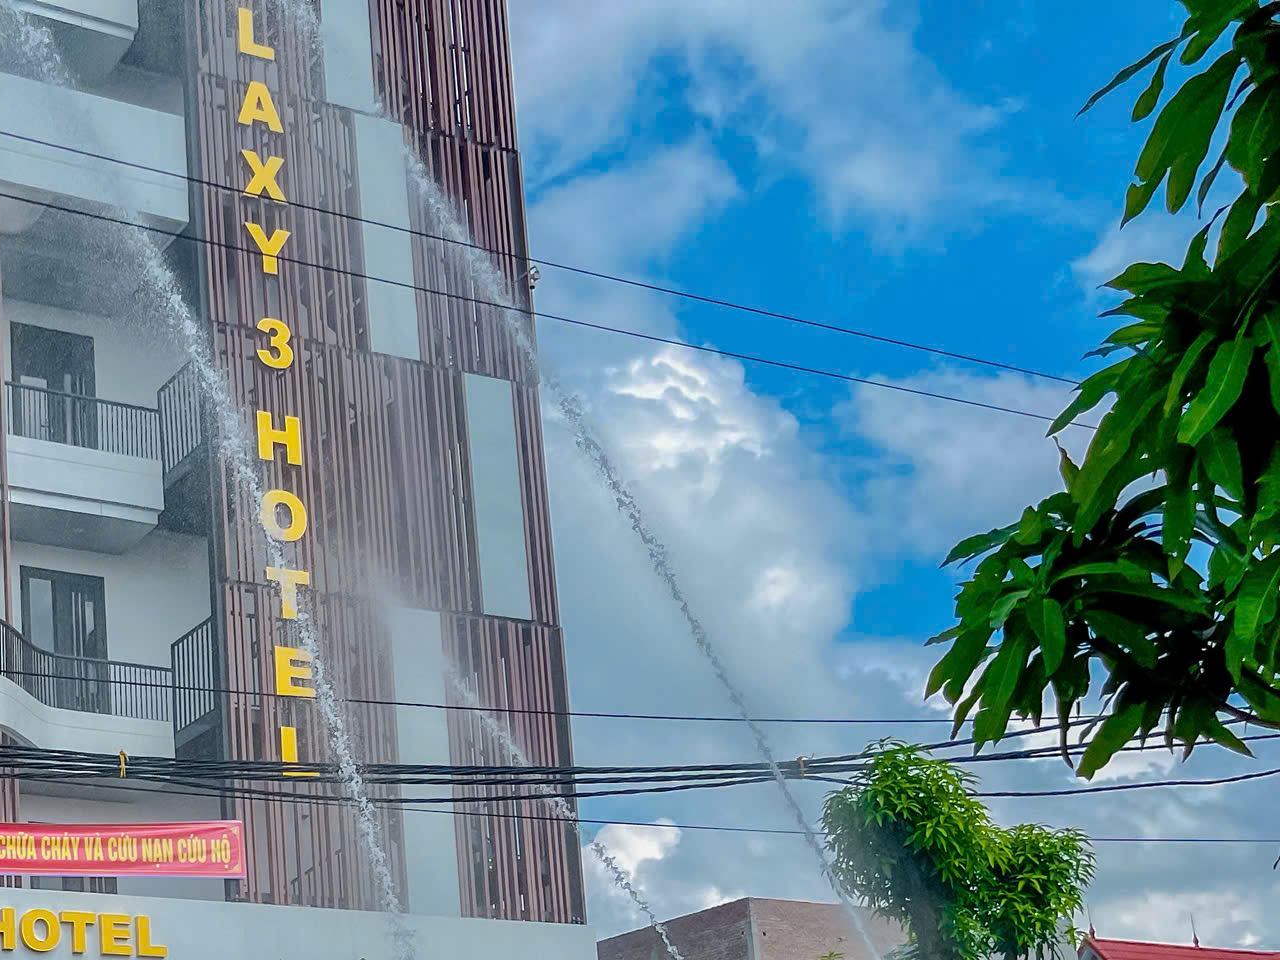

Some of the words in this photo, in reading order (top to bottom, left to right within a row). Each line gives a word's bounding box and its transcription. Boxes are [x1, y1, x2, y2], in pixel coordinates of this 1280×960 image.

[237, 7, 291, 275] LAXY
[256, 317, 294, 369] 3
[256, 410, 321, 777] HOTEL
[41, 832, 80, 861] CHÁY
[84, 832, 104, 861] VÀ
[107, 832, 137, 862] CỨU
[142, 837, 173, 868] NẠN
[177, 833, 206, 863] CỨU
[210, 834, 231, 869] HỘ
